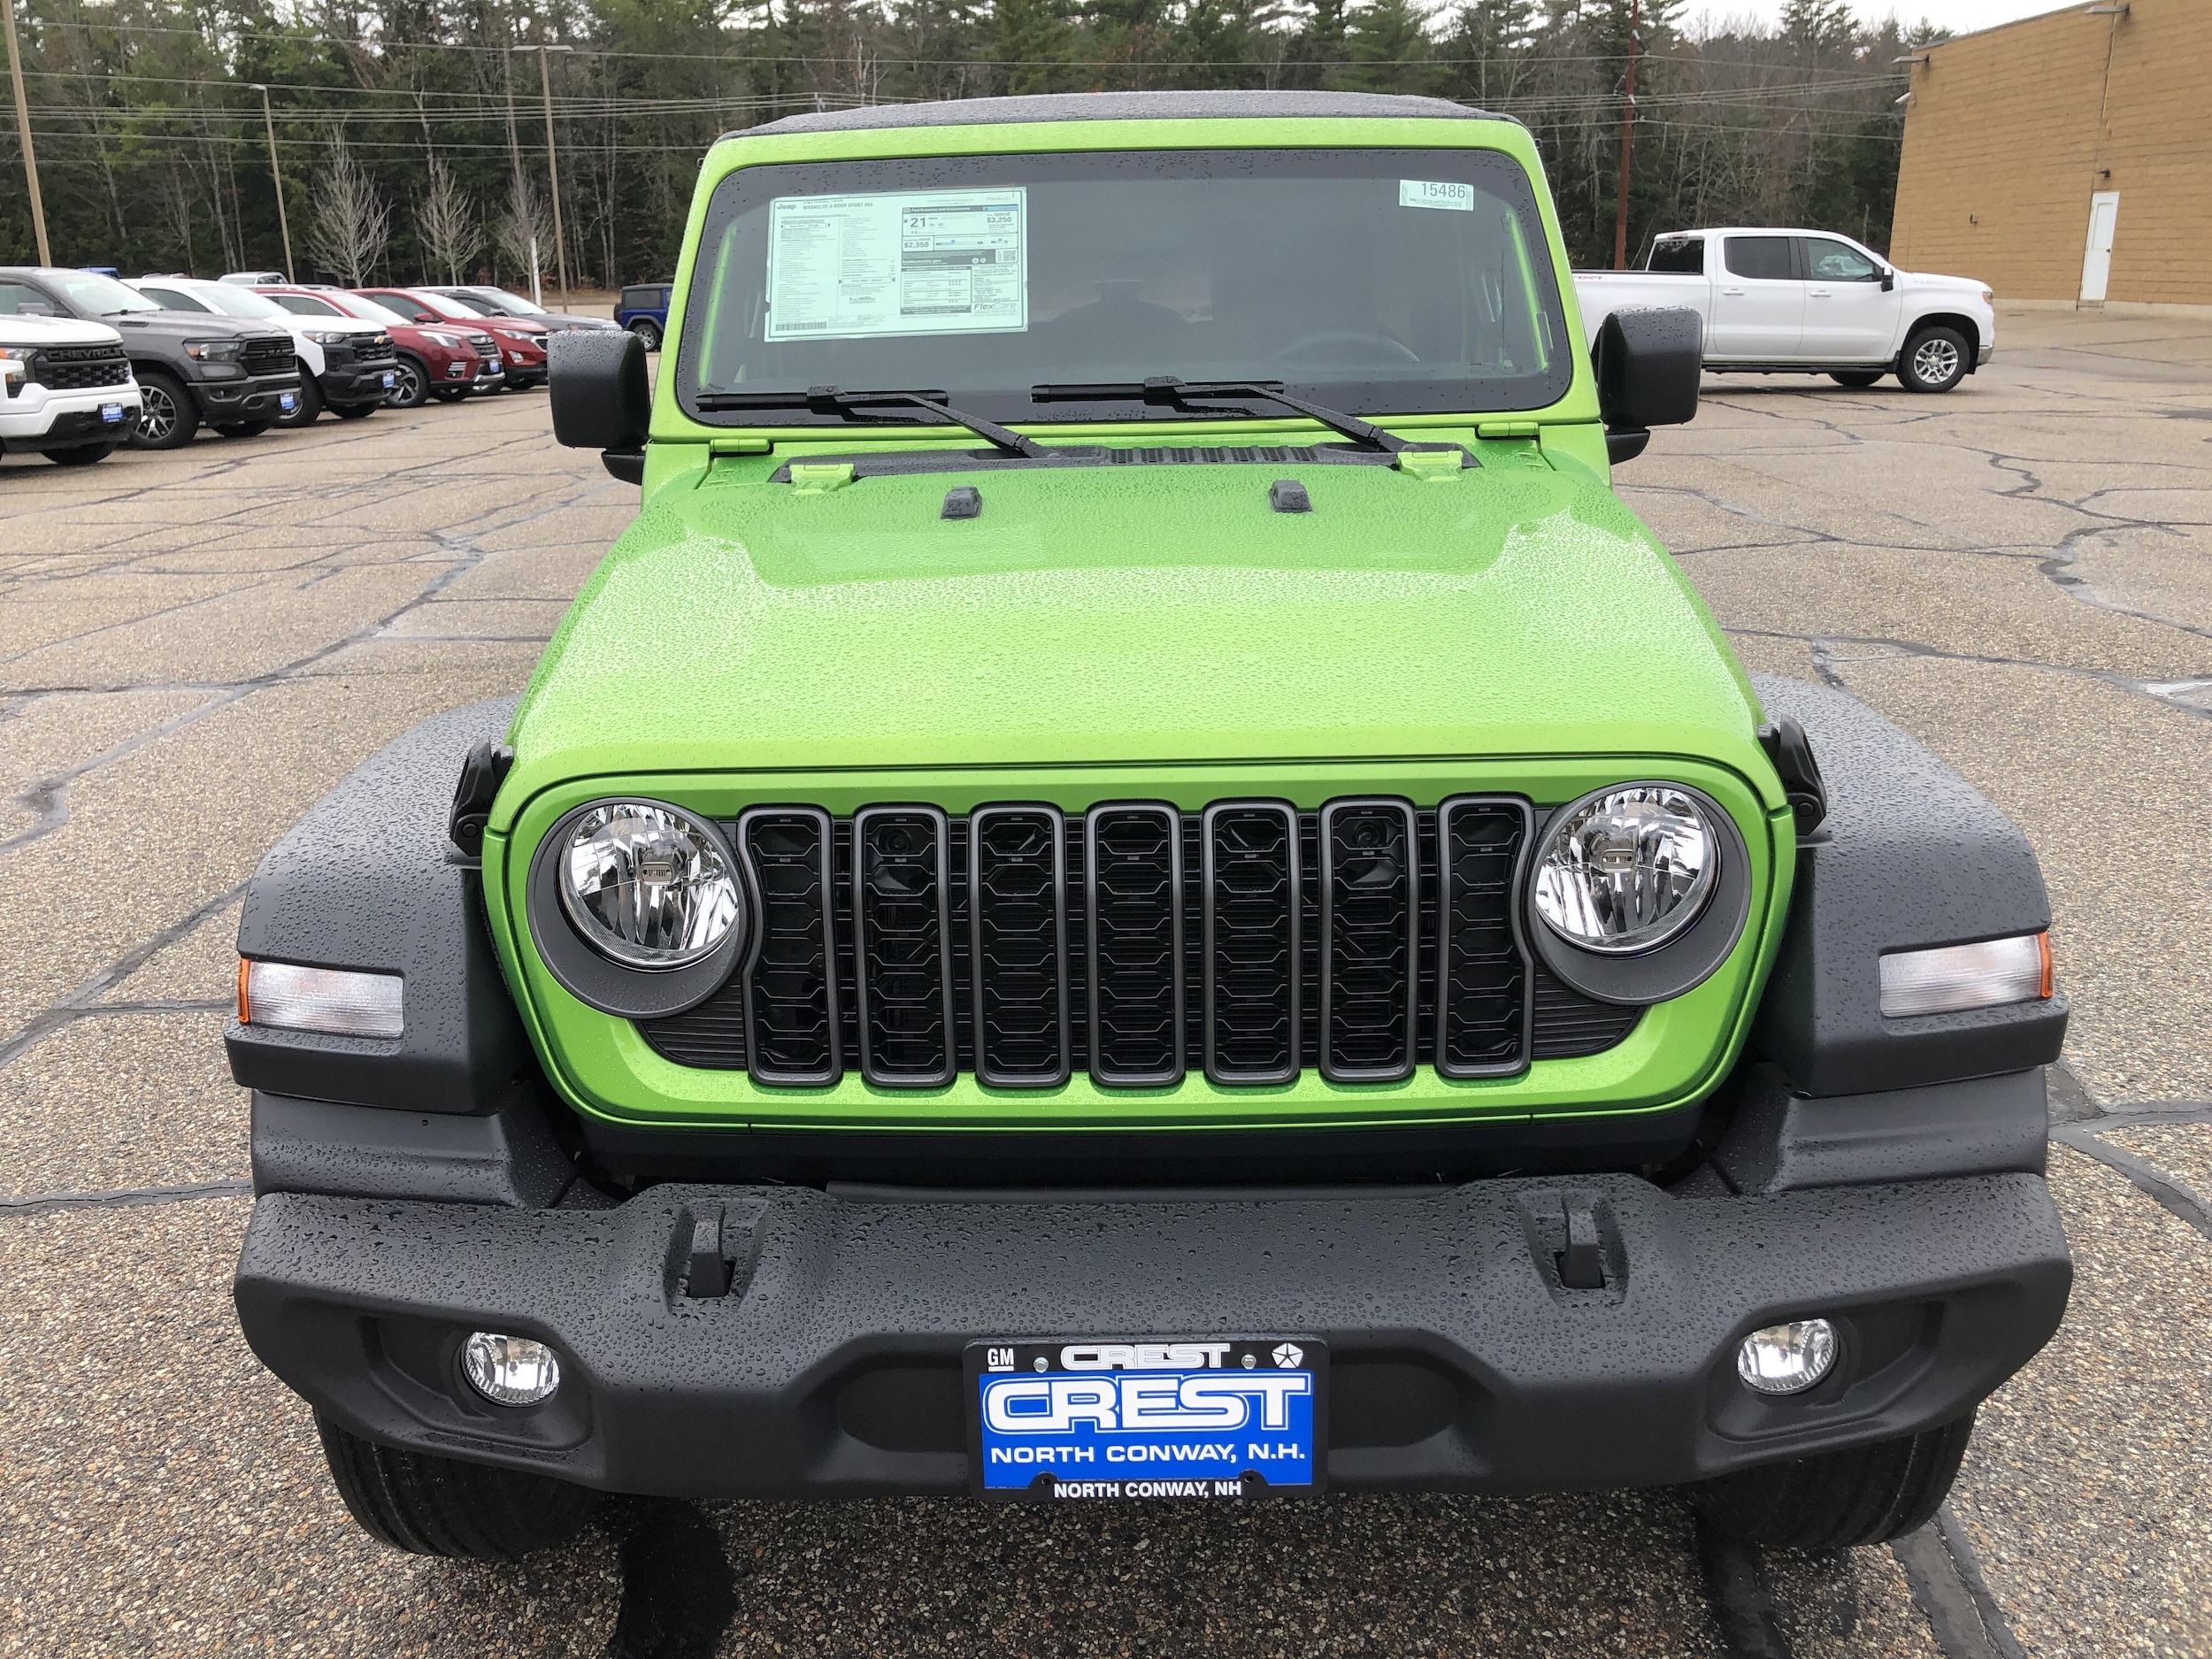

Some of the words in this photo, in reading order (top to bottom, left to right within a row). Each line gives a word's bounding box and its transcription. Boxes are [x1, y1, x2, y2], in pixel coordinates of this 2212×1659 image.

[1422, 183, 1465, 198] 15486
[910, 218, 926, 227] 21
[987, 1348, 1015, 1365] GM
[1060, 1343, 1231, 1370] CREST
[983, 1373, 1311, 1435] CREST
[991, 1447, 1094, 1464] NORTH
[1106, 1444, 1238, 1464] CONWAY,
[1248, 1443, 1306, 1460] N.H.
[1054, 1482, 1119, 1498] NORTH
[1125, 1481, 1209, 1499] CONWAY,
[1215, 1481, 1241, 1495] NH
